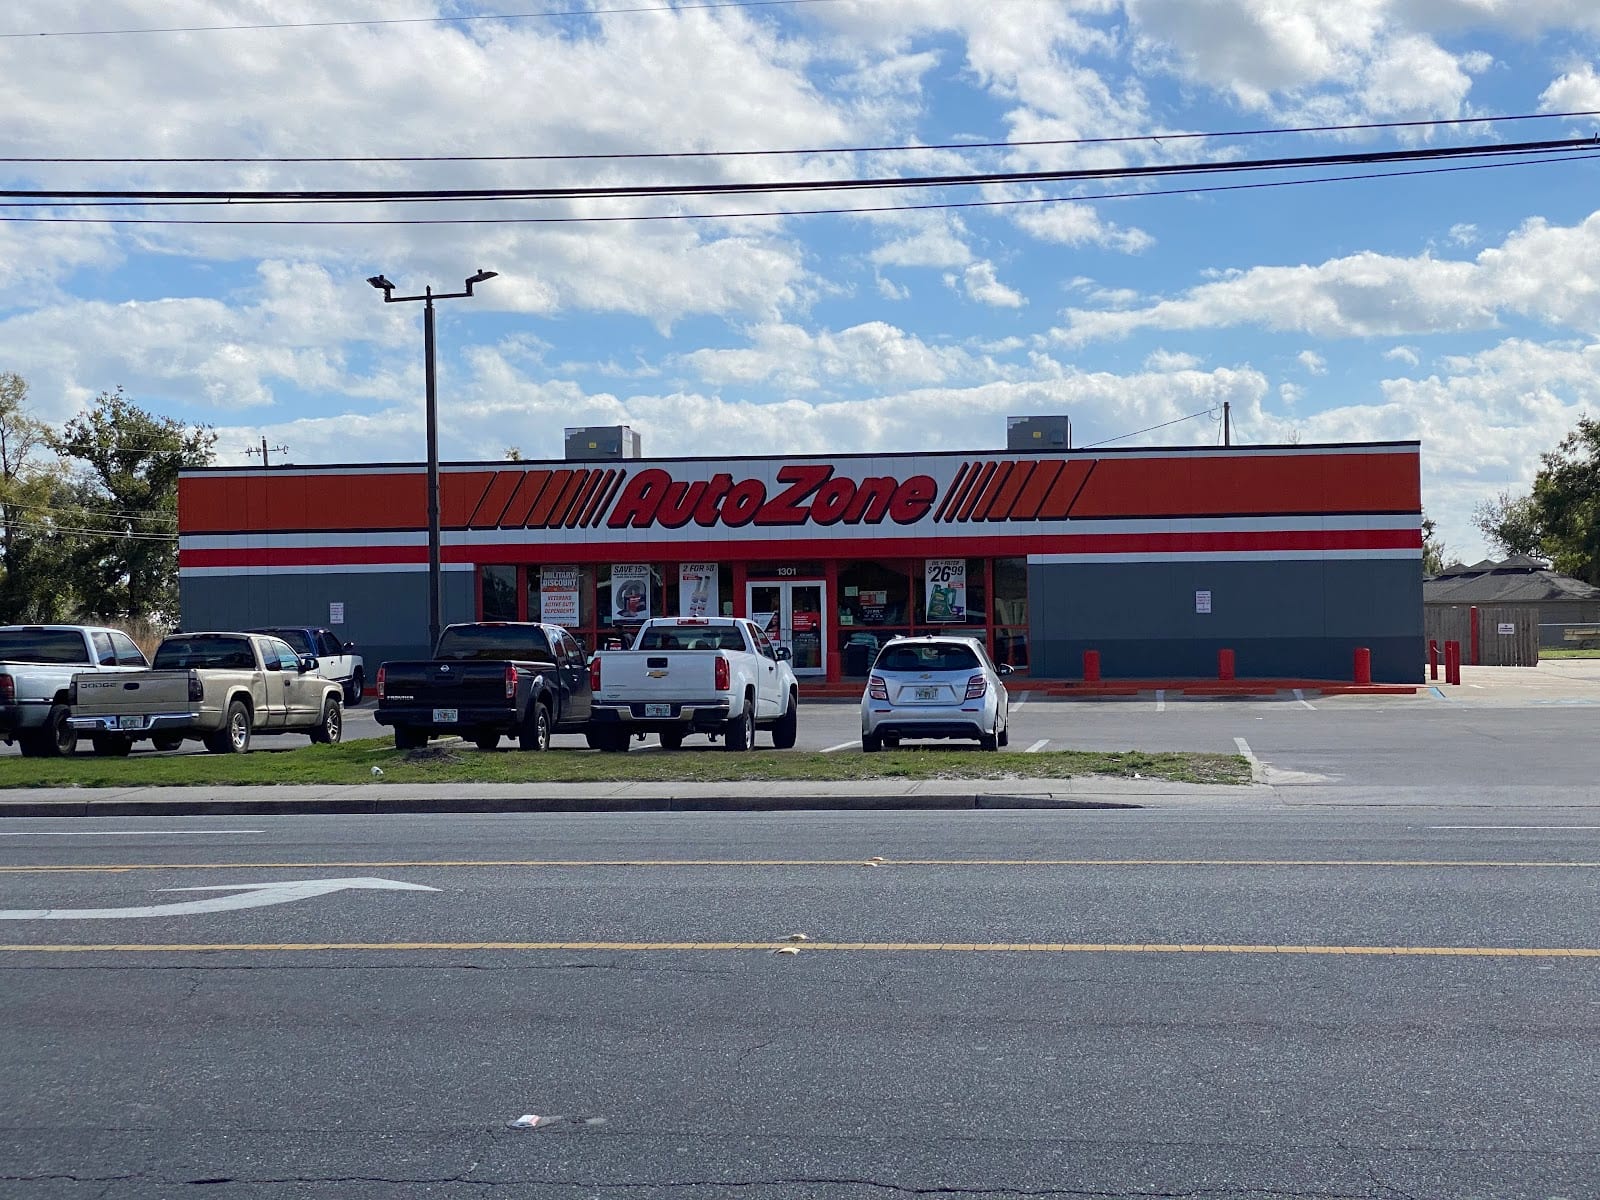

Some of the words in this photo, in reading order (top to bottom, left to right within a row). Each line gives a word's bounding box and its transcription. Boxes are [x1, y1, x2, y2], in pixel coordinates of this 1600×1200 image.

[607, 464, 938, 529] AutoZone
[614, 565, 633, 574] SAVE
[682, 564, 689, 573] 2
[689, 564, 705, 573] FOR
[776, 567, 797, 576] 1301
[543, 571, 575, 580] MILITARY
[542, 579, 577, 587] DISCOUNT
